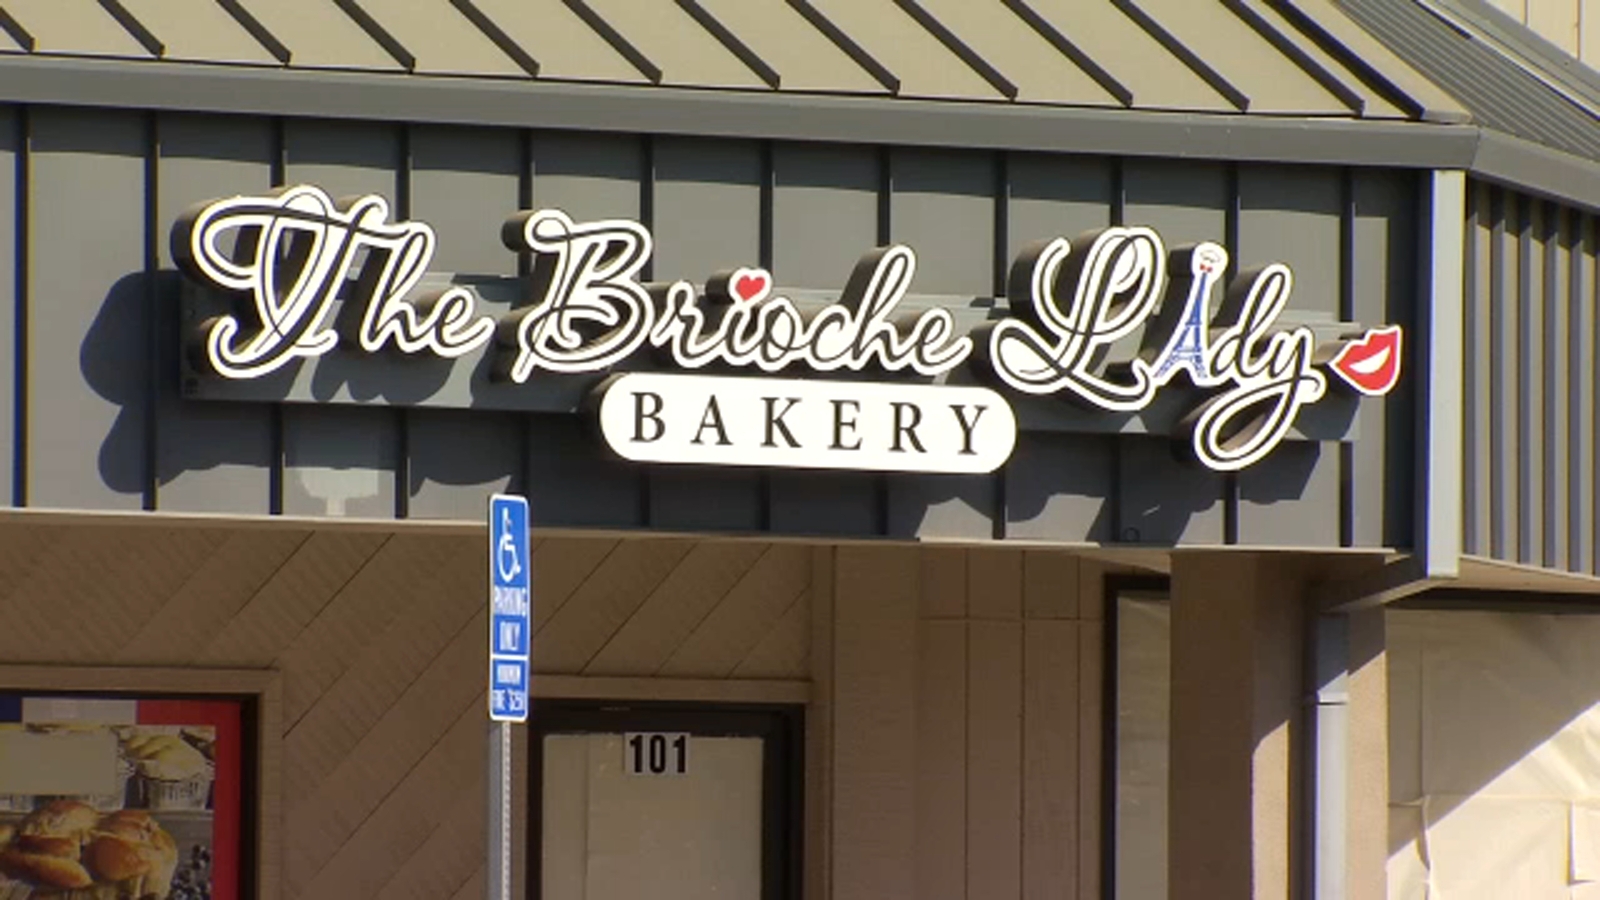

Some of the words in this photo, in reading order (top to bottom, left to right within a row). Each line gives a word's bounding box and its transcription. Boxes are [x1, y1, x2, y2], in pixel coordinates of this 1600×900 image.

[193, 184, 497, 380] The
[510, 209, 972, 383] Brioche
[629, 391, 988, 455] BAKERY
[629, 734, 686, 773] 101
